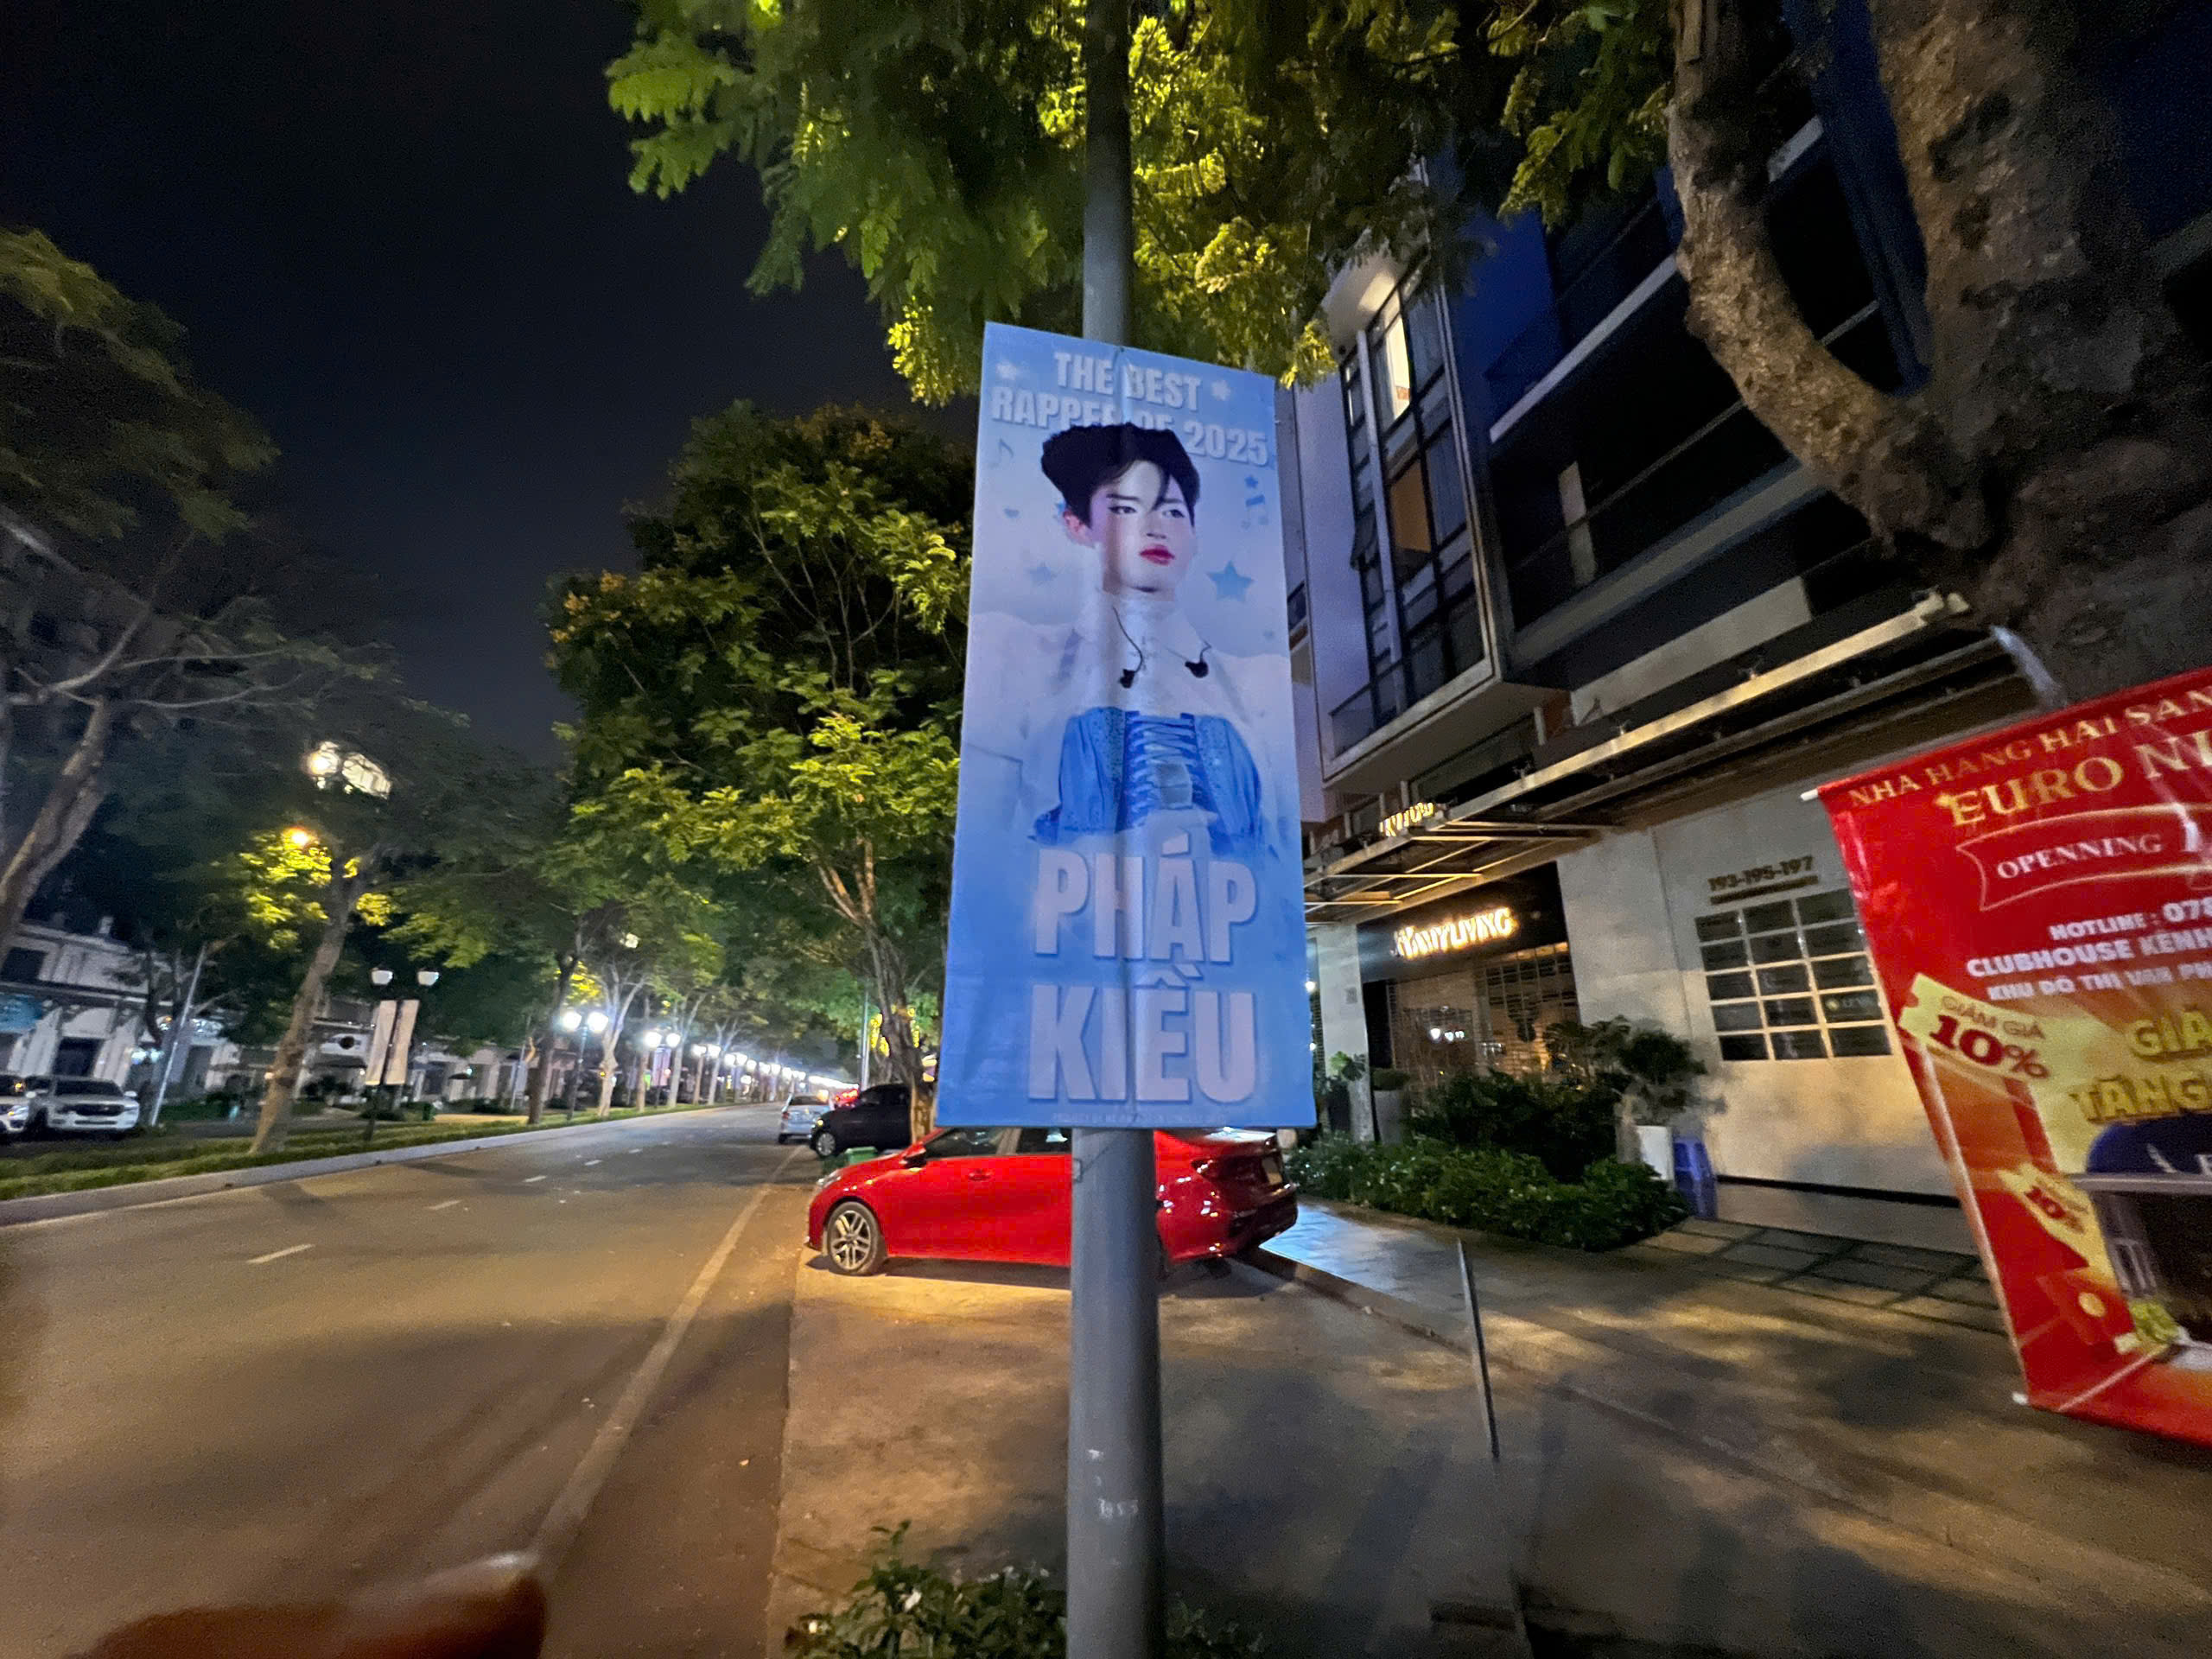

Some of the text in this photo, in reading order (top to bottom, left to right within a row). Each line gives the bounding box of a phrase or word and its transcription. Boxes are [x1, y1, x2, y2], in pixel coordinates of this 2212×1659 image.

[1054, 352, 1202, 411] THE BEST
[1184, 419, 1269, 467] 2025
[1848, 774, 1923, 807] NHA
[1925, 739, 2032, 786] HANG
[2037, 715, 2119, 753] HAI
[1948, 756, 2125, 827] EURO
[1996, 833, 2162, 880] OPENNING
[1034, 830, 1257, 963] PHÁP
[1967, 938, 2135, 978] CLUBHOUSE
[1028, 963, 1256, 1104] KIỀU
[1929, 1014, 2051, 1079] 10%
